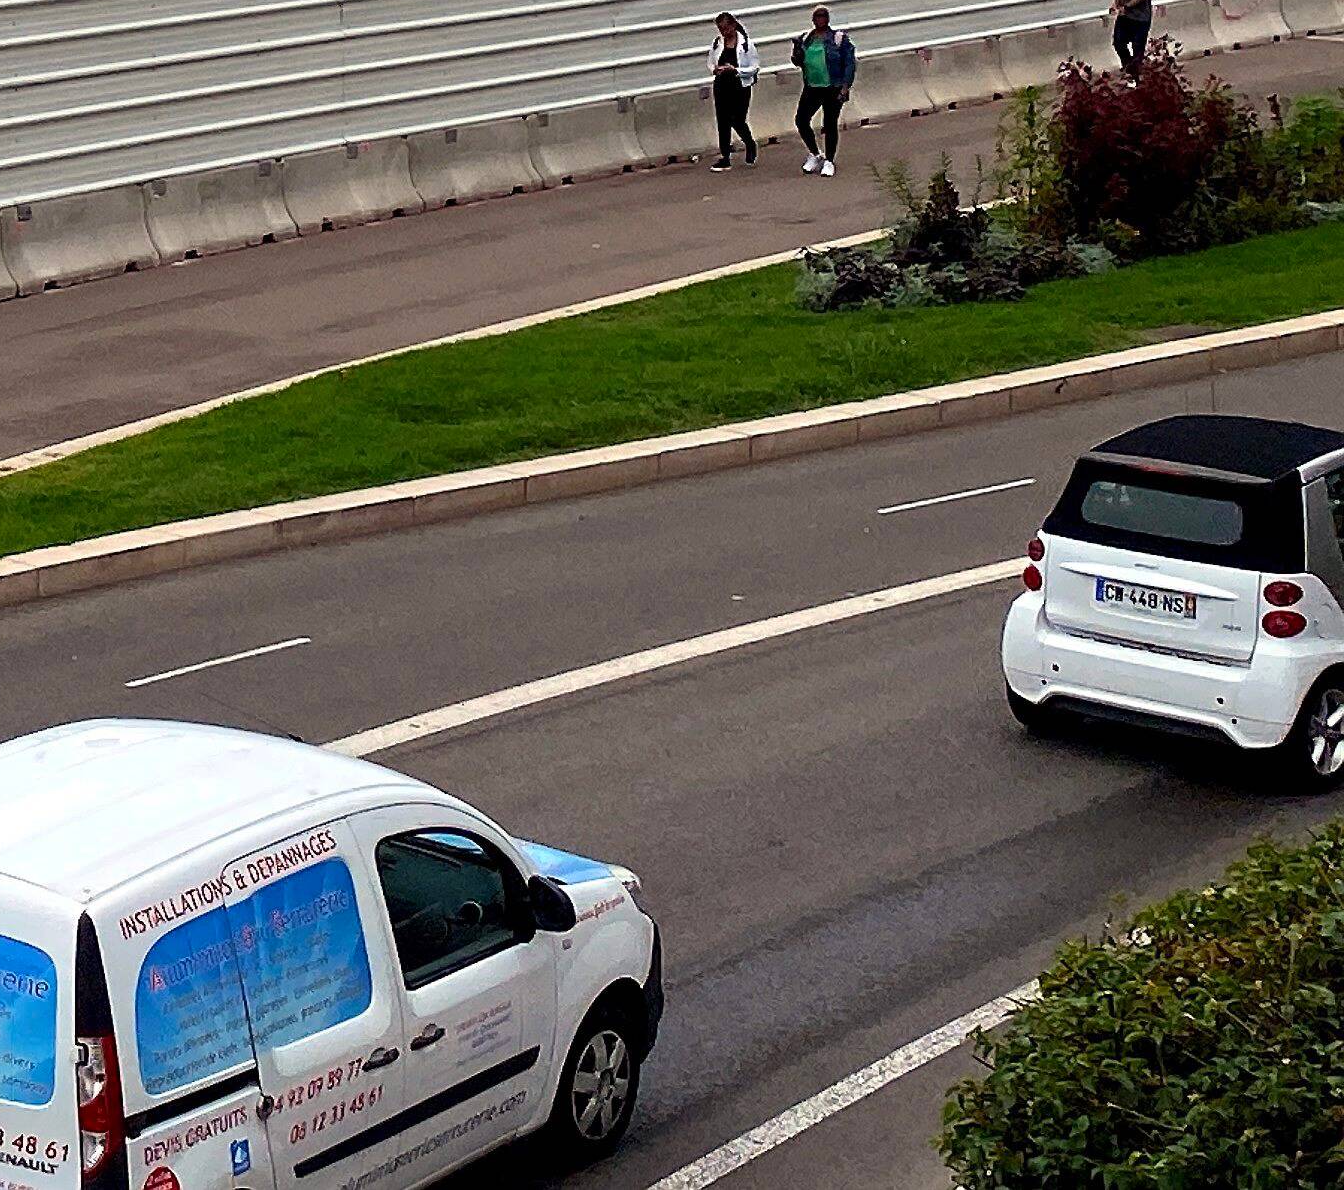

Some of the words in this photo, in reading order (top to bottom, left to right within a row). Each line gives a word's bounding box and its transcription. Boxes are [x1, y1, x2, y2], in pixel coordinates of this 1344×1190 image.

[119, 874, 232, 940] INSTALLATIONS
[233, 869, 248, 890] &
[247, 829, 337, 884] DEPANNAGES
[12, 1133, 38, 1155] 48
[45, 1141, 69, 1162] 61
[143, 1133, 182, 1166] DEVIS
[185, 1104, 249, 1150] GRATUITS
